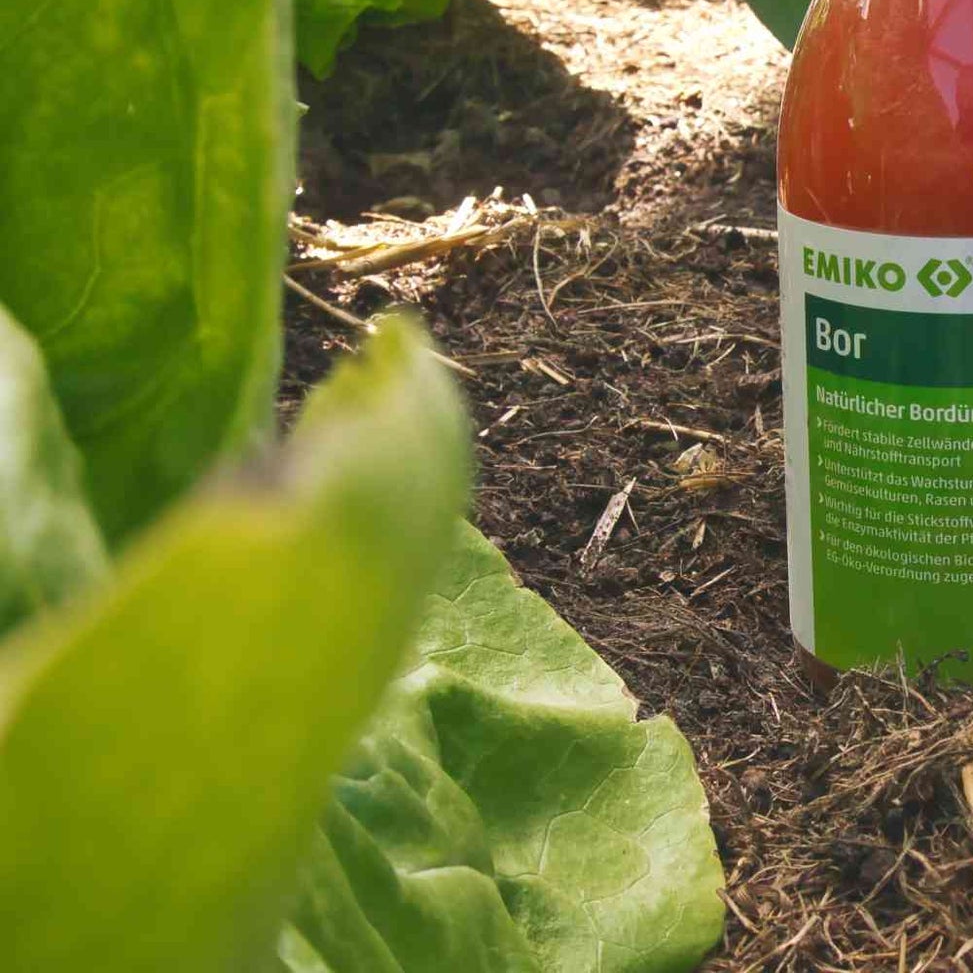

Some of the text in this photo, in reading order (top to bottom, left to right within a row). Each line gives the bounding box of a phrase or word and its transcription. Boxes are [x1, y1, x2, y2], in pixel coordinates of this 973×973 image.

[802, 246, 906, 292] EMIKO
[815, 317, 867, 359] Bor
[816, 385, 905, 420] Natürlicher
[823, 419, 859, 437] Fördert
[862, 430, 904, 446] stabile
[824, 439, 961, 469] und Nährstofftransport
[824, 458, 883, 483] Unterstützt
[886, 474, 908, 486] das
[825, 475, 922, 506] Gemüsekulturen,
[926, 493, 966, 506] Rasen
[824, 495, 862, 519] Wichtig
[865, 507, 881, 520] für
[885, 511, 905, 524] die
[842, 517, 932, 543] Enzymaktivität
[935, 533, 957, 545] der
[843, 538, 862, 553] den
[866, 544, 951, 567] ökologischen
